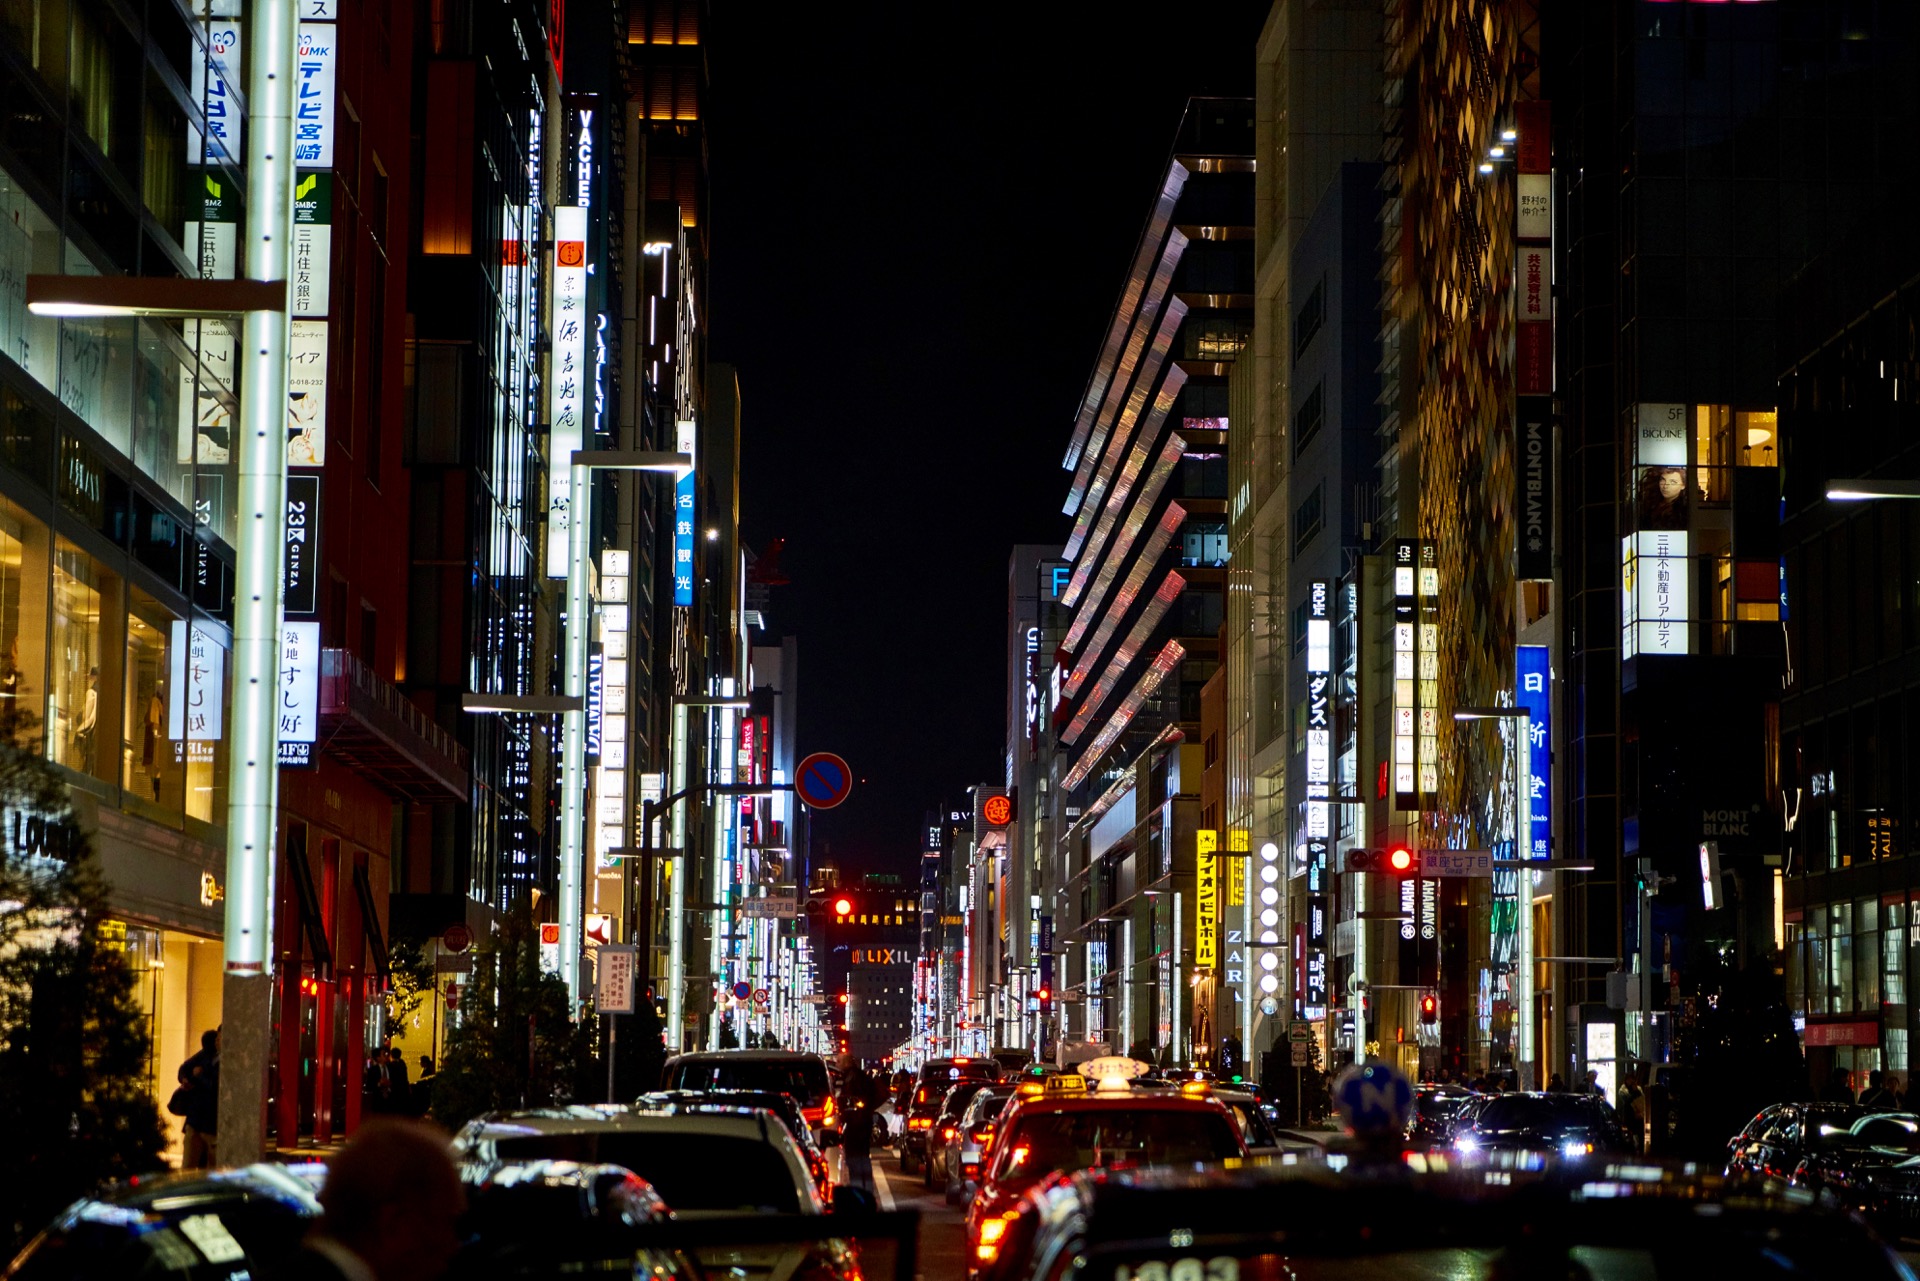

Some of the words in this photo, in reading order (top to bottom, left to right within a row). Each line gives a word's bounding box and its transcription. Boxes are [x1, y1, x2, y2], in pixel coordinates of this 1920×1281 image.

[300, 47, 329, 56] UMK
[296, 62, 323, 160] テレビ宮崎
[295, 201, 317, 209] SMBC
[1521, 195, 1547, 205] 野村の
[297, 229, 311, 311] 三井住友銀行
[1527, 254, 1541, 314] 共立美容外科
[290, 351, 320, 364] イア
[1668, 408, 1683, 421] 5F
[1642, 429, 1683, 439] BIGUINE
[1527, 423, 1542, 536] MONTBLANC
[677, 494, 693, 590] 名鉄観光
[290, 545, 299, 587] GINZA
[1053, 568, 1070, 597] F
[1657, 534, 1671, 649] 三井不動産リアルティ
[281, 631, 302, 733] 築地すし好
[588, 653, 603, 758] DAMIANI
[1310, 676, 1328, 726] ダンス
[1703, 810, 1749, 822] MONT
[1703, 824, 1749, 836] BLANC
[1426, 855, 1488, 868] 銀座七丁目
[747, 902, 794, 912] 銀座七丁目
[1200, 852, 1214, 959] ライオンビヤホール
[1402, 879, 1415, 925] YMAHA
[867, 949, 912, 965] LIXIL
[1099, 1063, 1129, 1073] チェッカー
